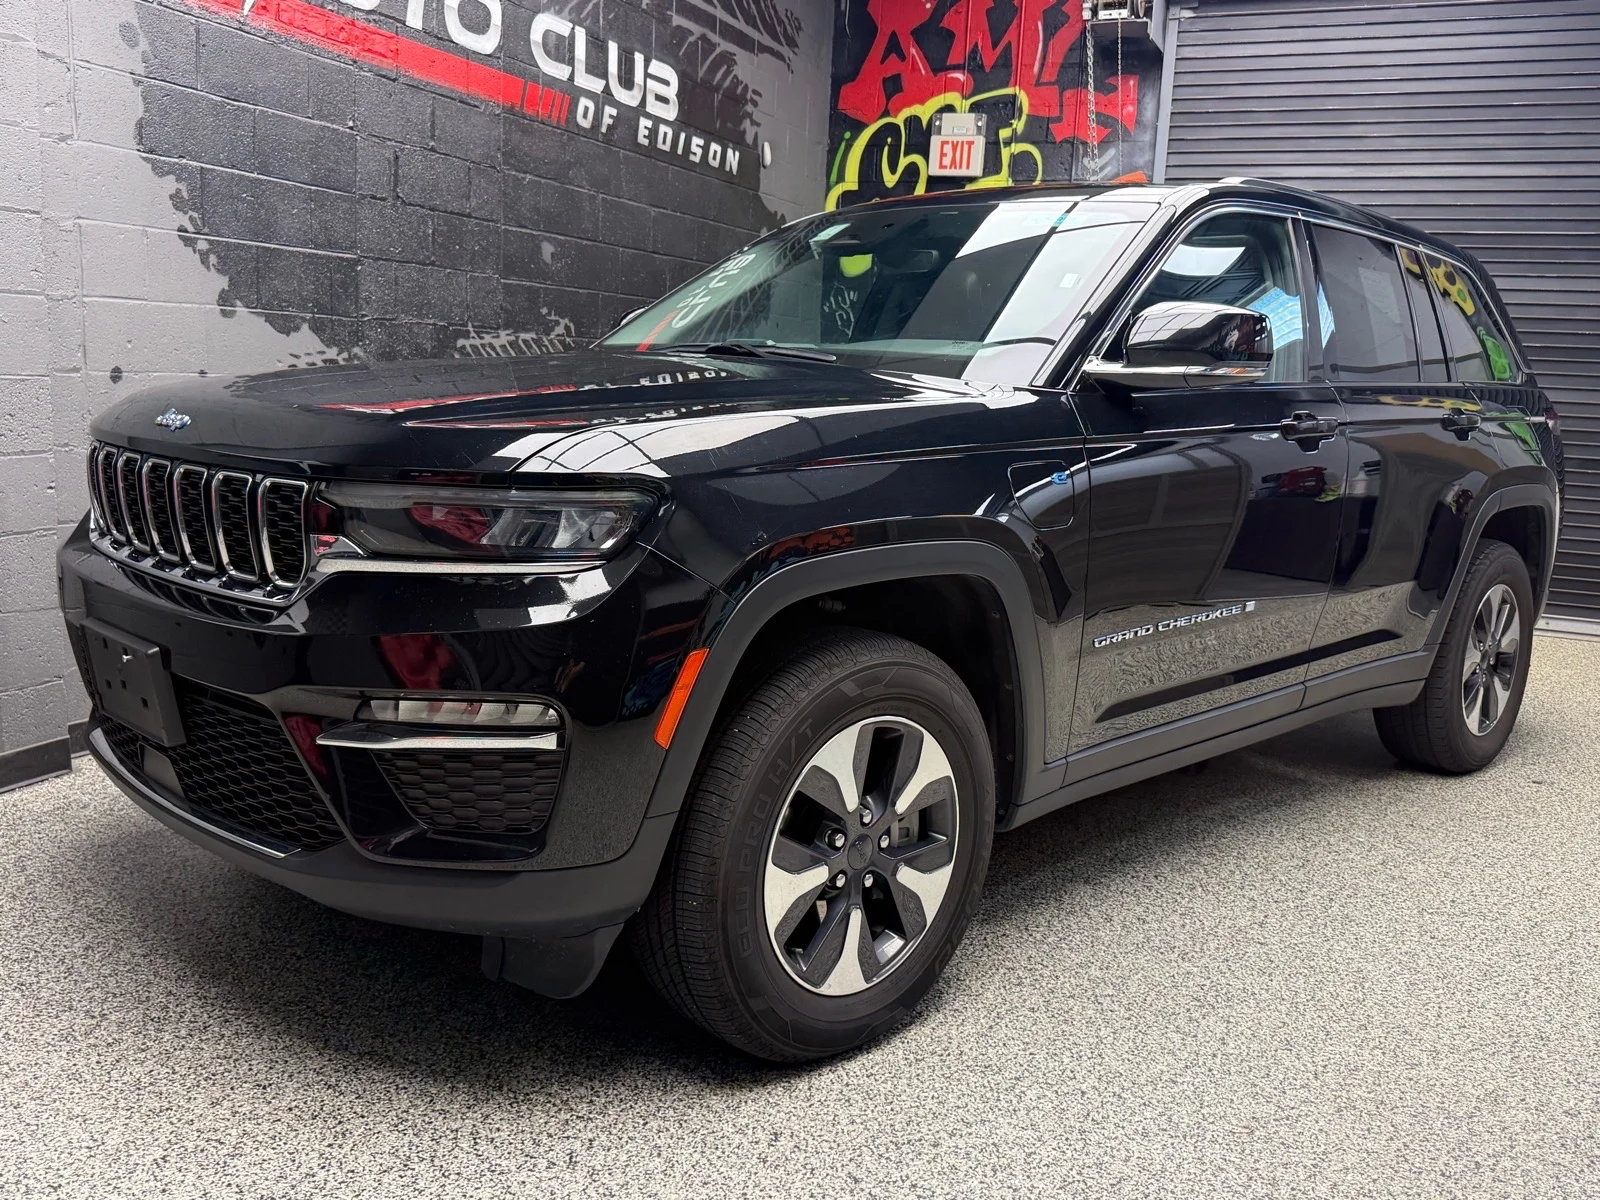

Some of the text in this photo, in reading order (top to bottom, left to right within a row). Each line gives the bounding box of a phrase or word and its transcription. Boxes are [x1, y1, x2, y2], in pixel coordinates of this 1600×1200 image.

[529, 12, 679, 122] CLUB
[576, 96, 740, 176] OF EDISON
[938, 140, 976, 171] EXIT
[1093, 604, 1242, 648] GRAND CHEROKEE
